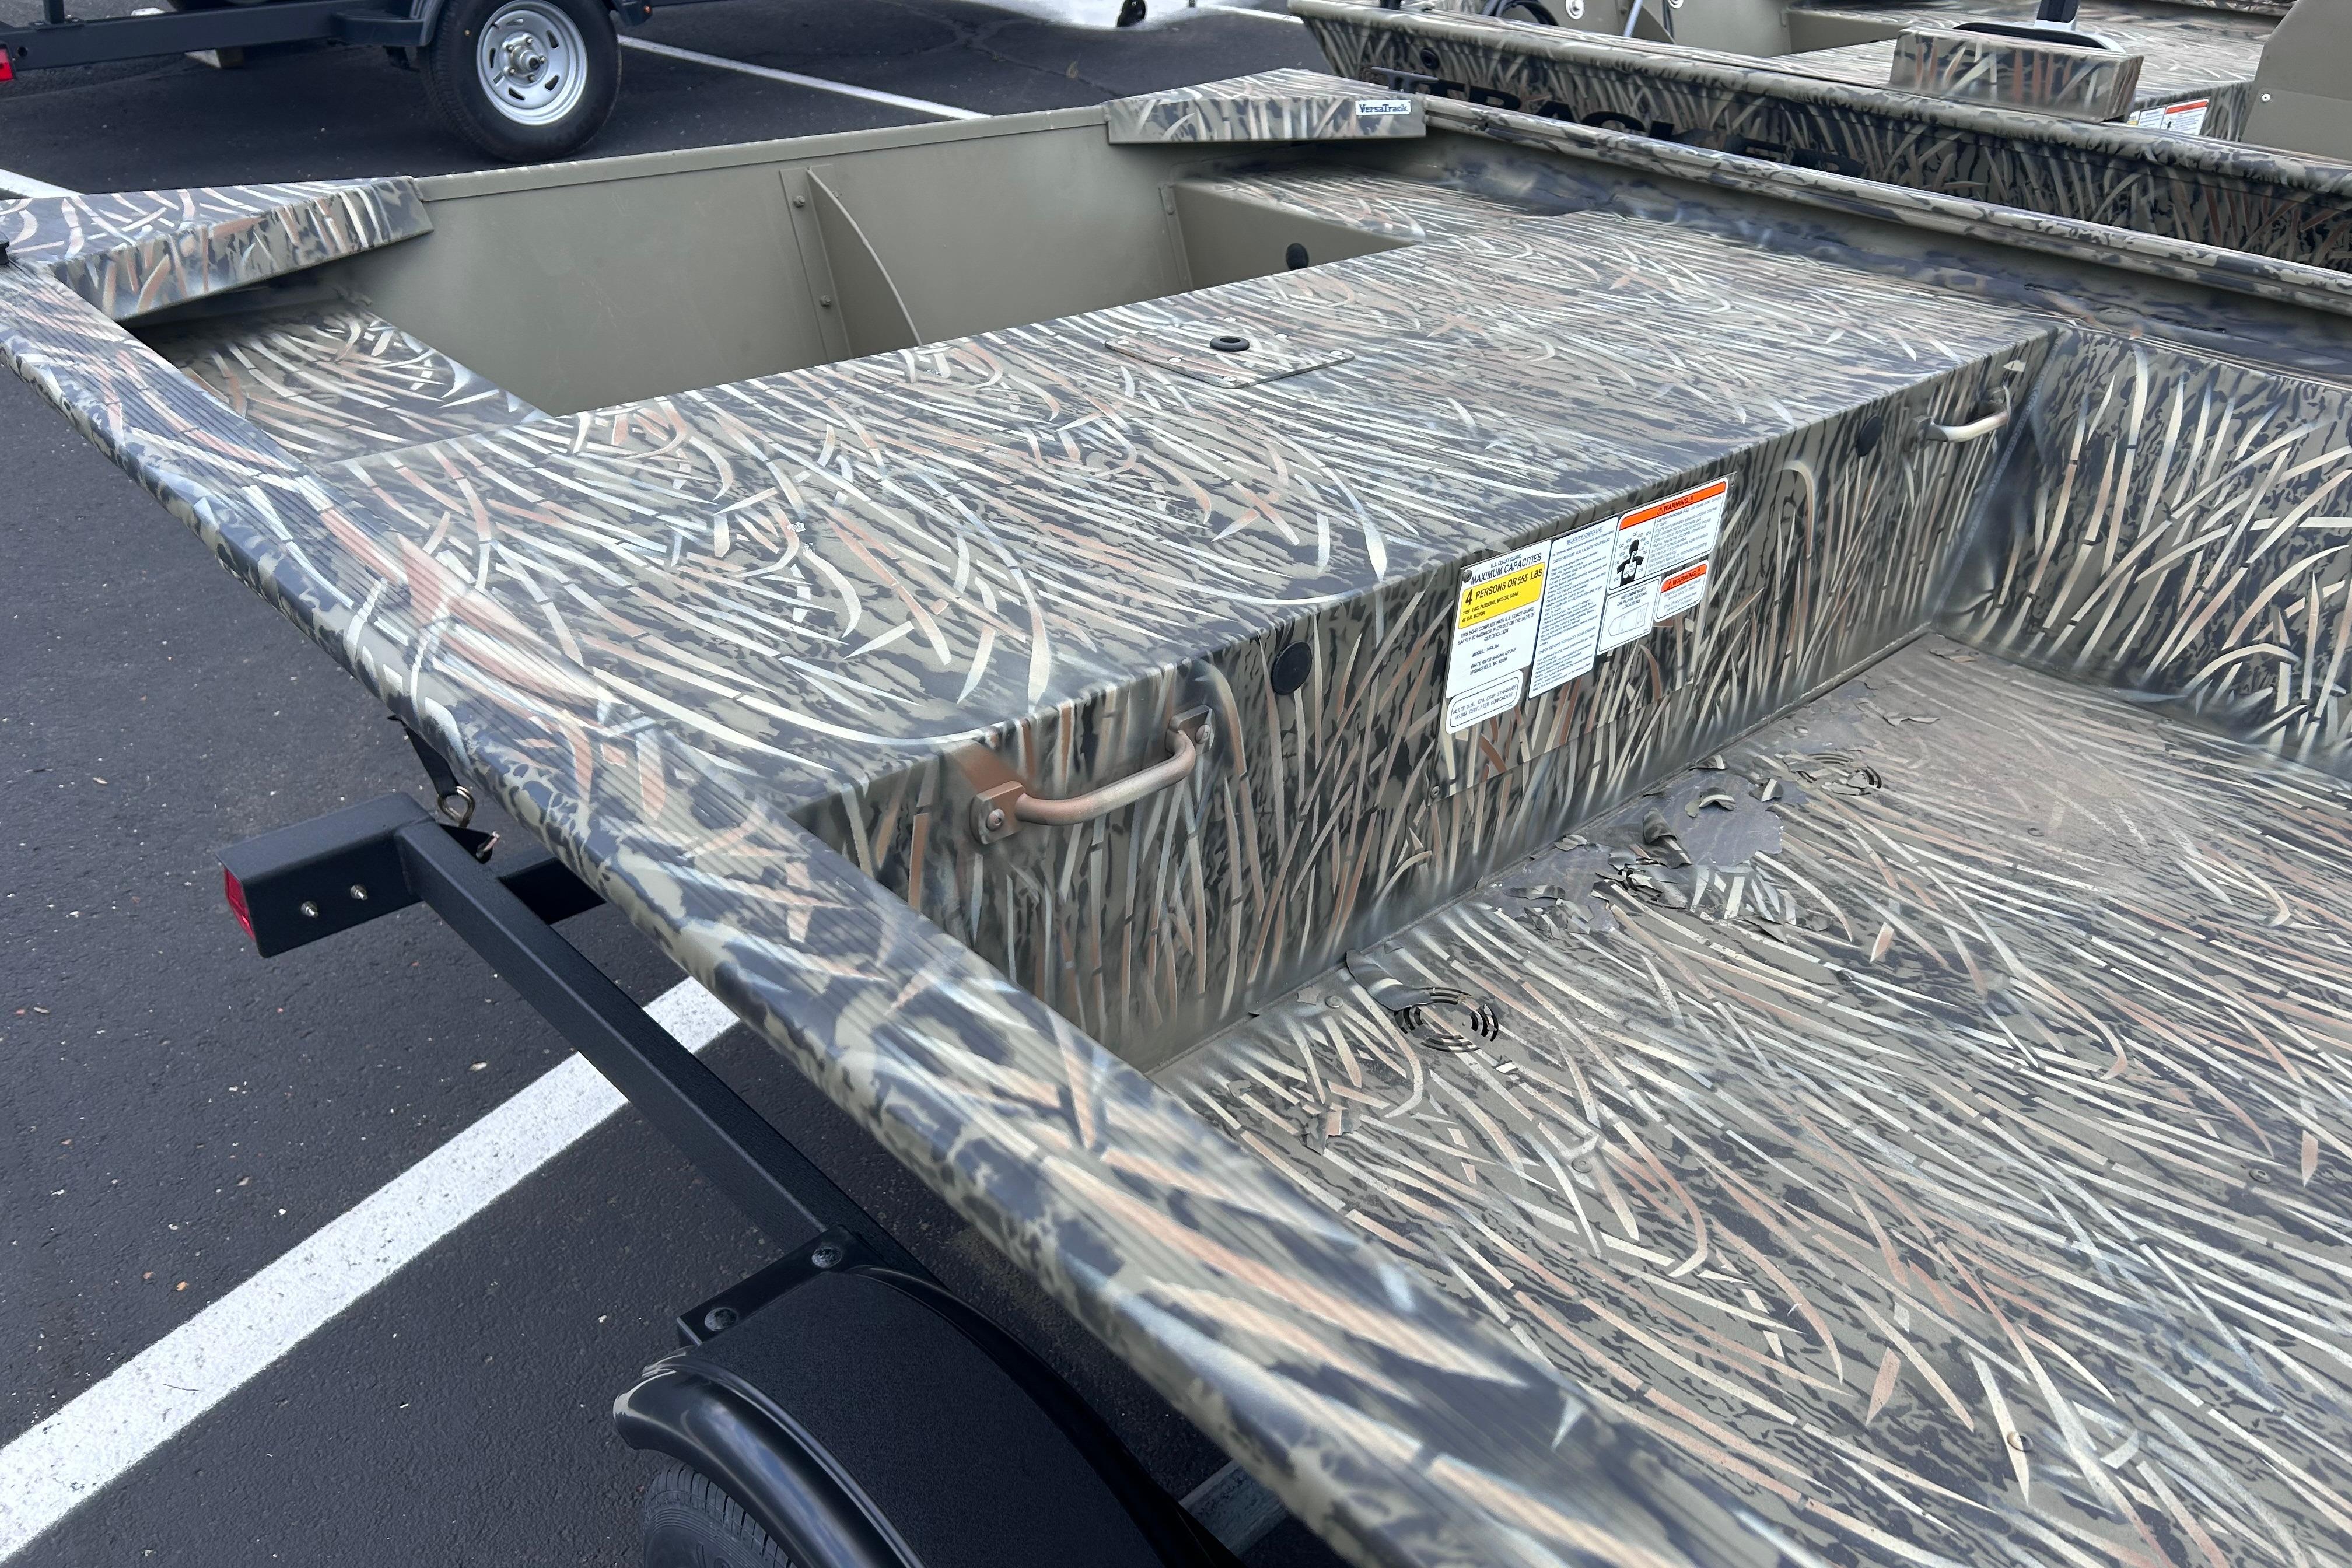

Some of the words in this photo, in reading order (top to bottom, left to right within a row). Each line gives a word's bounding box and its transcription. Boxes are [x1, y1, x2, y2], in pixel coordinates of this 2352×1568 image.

[1359, 103, 1408, 113] VersaTrack
[1663, 498, 1689, 512] WARNING
[1471, 566, 1502, 585] MAXIMUM
[1504, 553, 1542, 573] CAPACITIES
[1465, 589, 1473, 605] 4
[1475, 582, 1506, 600] PERSONS
[1507, 578, 1516, 587] OR
[1517, 574, 1528, 584] 555
[1530, 569, 1542, 580] LBS
